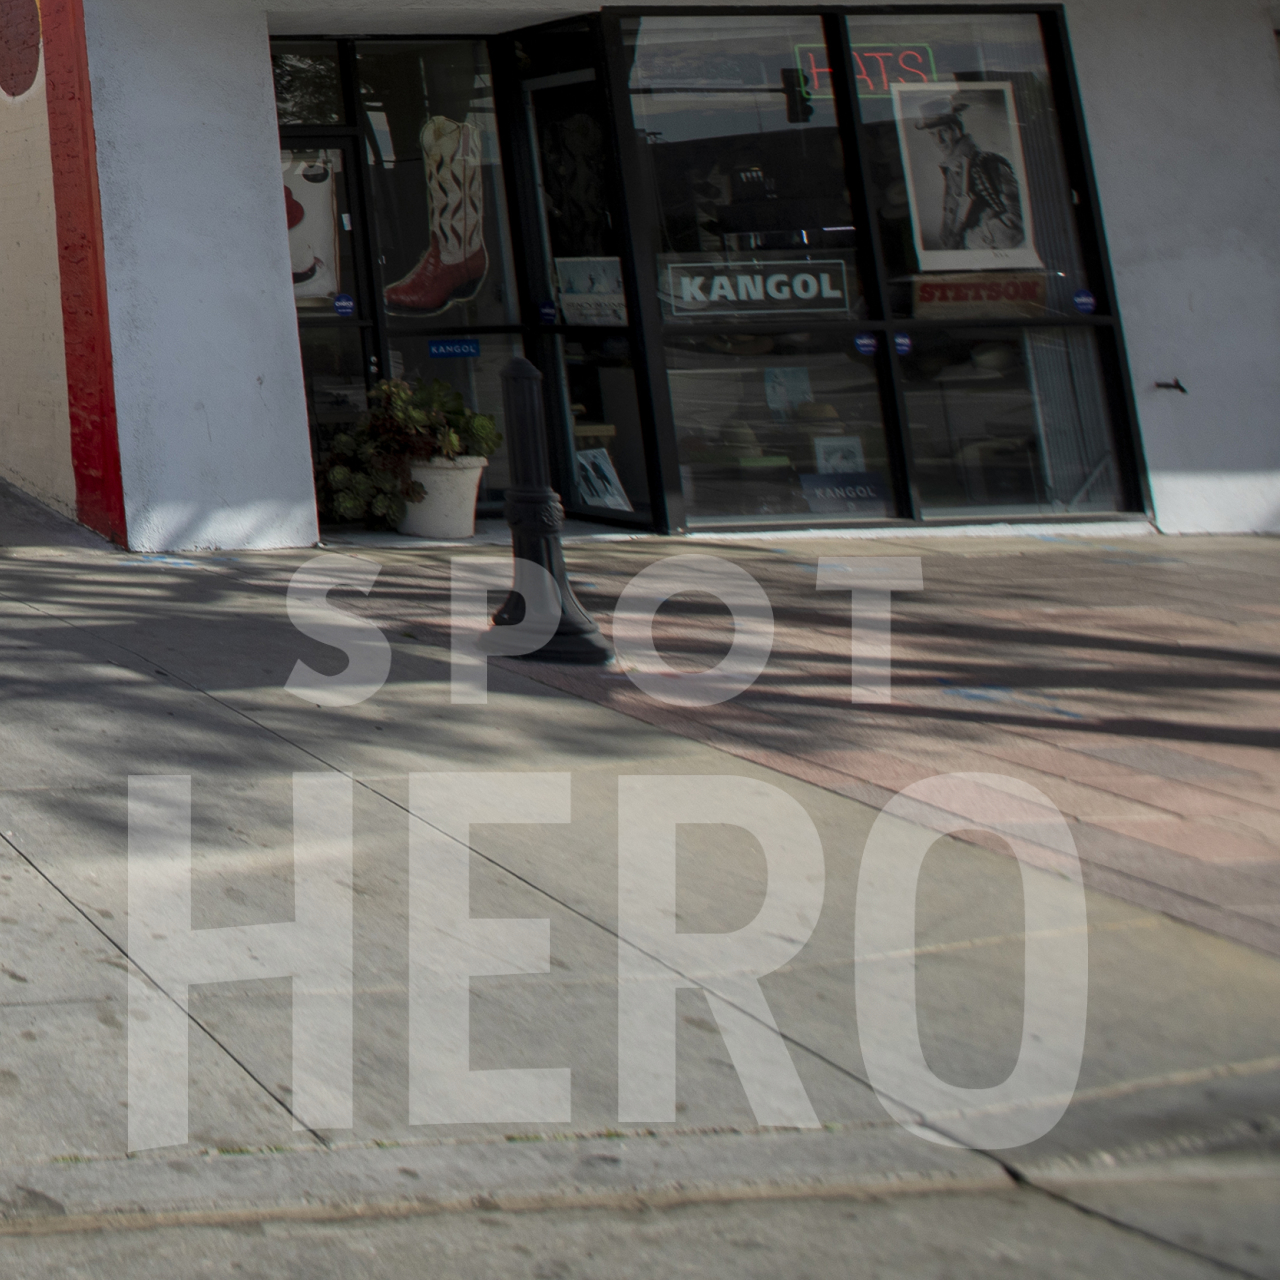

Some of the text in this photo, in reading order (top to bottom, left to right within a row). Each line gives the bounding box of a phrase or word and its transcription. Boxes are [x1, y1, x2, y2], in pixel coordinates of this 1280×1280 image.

[680, 272, 843, 303] KANGOL
[919, 281, 1040, 303] STETSON
[431, 344, 476, 354] KANGOL
[814, 484, 877, 500] KANGOL
